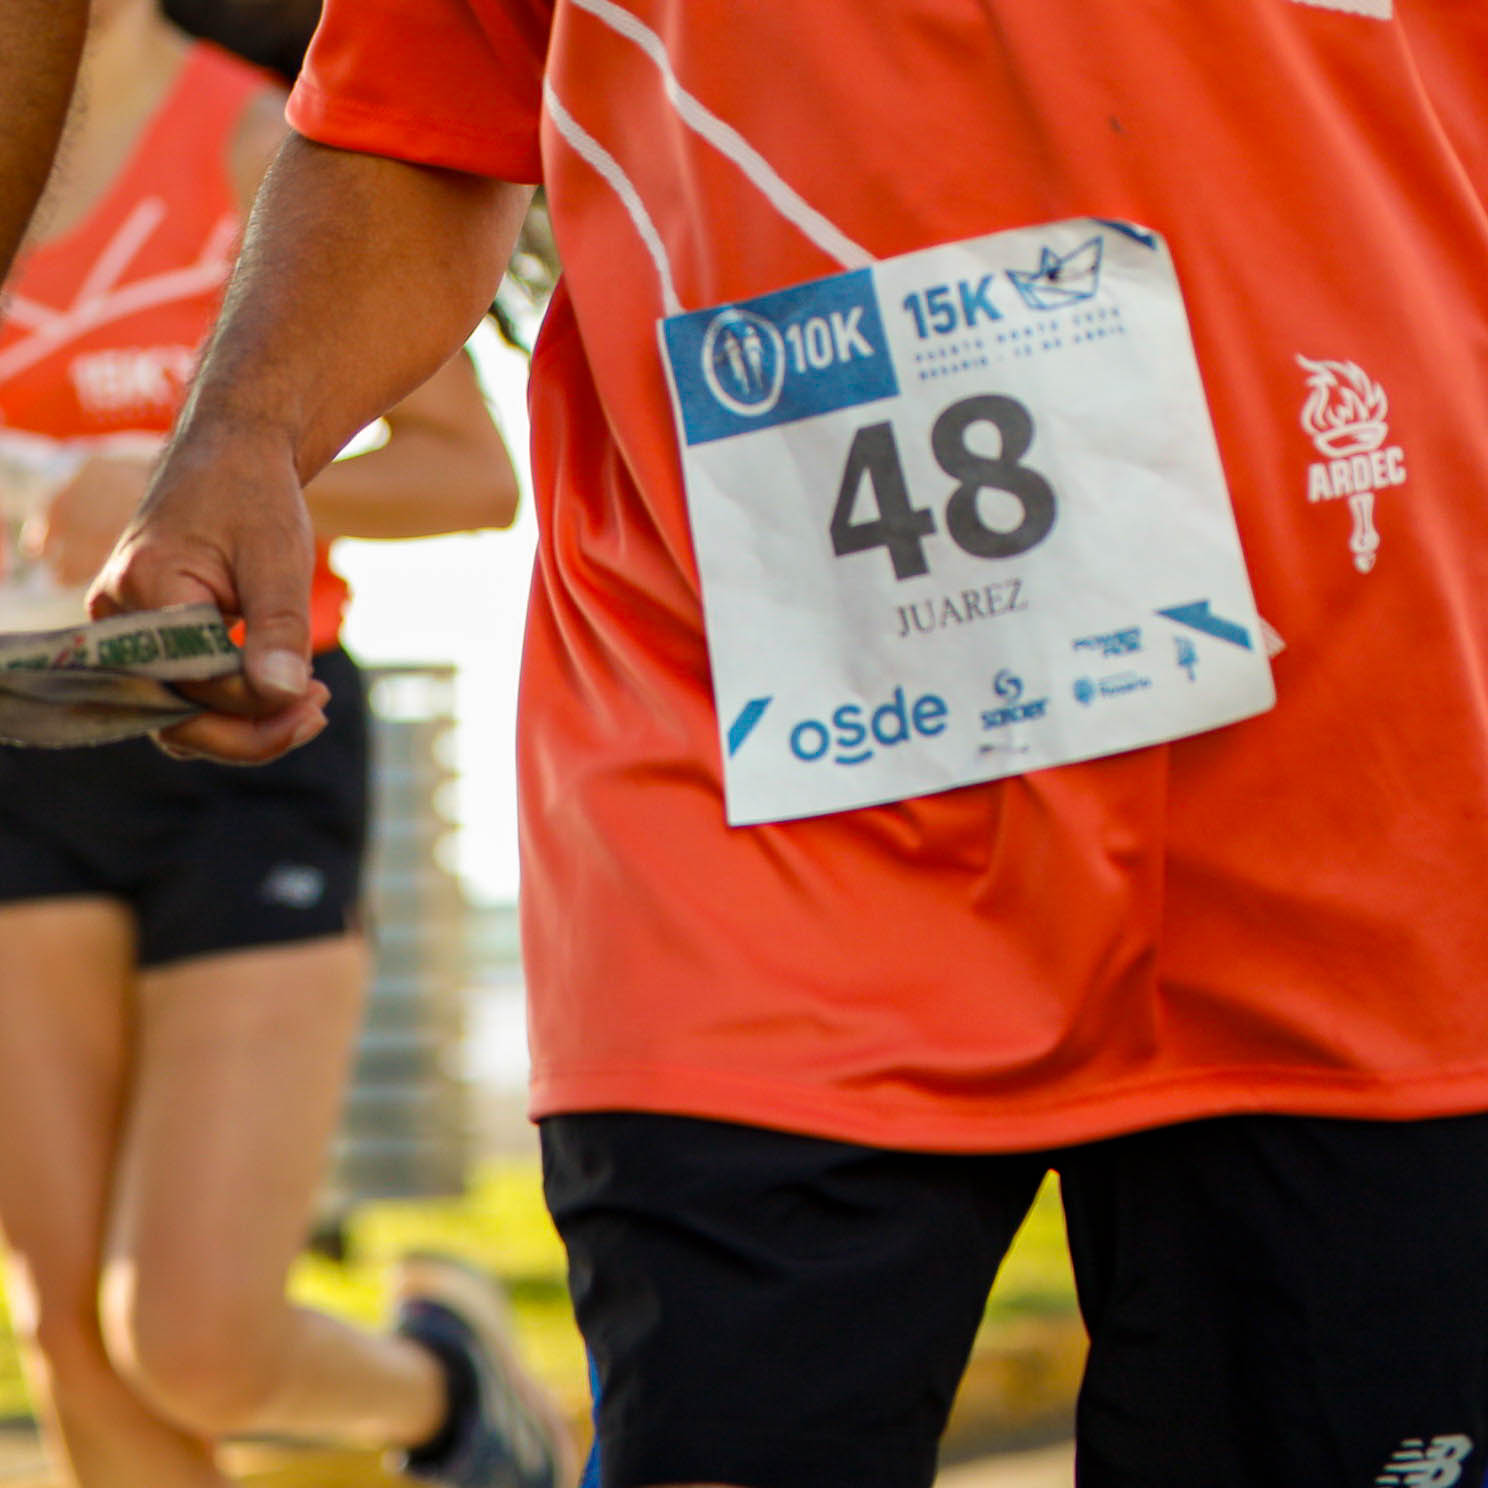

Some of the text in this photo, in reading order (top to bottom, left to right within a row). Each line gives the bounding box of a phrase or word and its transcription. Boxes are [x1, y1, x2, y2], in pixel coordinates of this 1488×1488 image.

[785, 306, 875, 374] 10K
[902, 273, 1004, 340] 15K
[828, 392, 1059, 582] 48
[1307, 446, 1407, 504] ARDEC
[894, 578, 1030, 638] JUAREZ
[788, 686, 949, 762] osde
